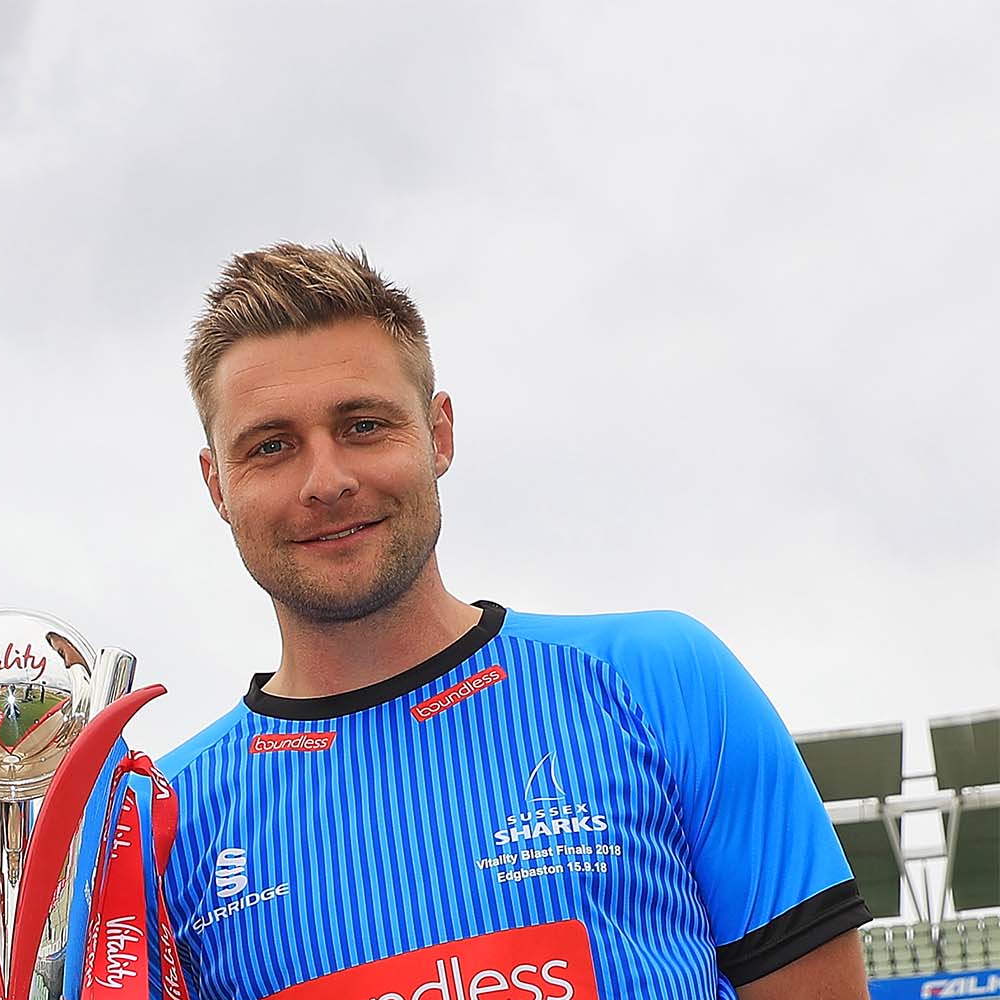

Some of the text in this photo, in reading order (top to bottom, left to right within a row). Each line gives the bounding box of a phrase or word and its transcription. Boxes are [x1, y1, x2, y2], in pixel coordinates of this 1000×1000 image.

[415, 670, 500, 717] boundless
[254, 735, 329, 751] boundless
[506, 803, 589, 826] SUSSEX
[493, 815, 608, 846] SHARKS
[476, 844, 622, 870] Vitality Blast Finals 2018
[497, 861, 608, 883] Edgbaston 15.9.18
[192, 882, 290, 935] SURRIDGE
[94, 915, 144, 989] Vitality
